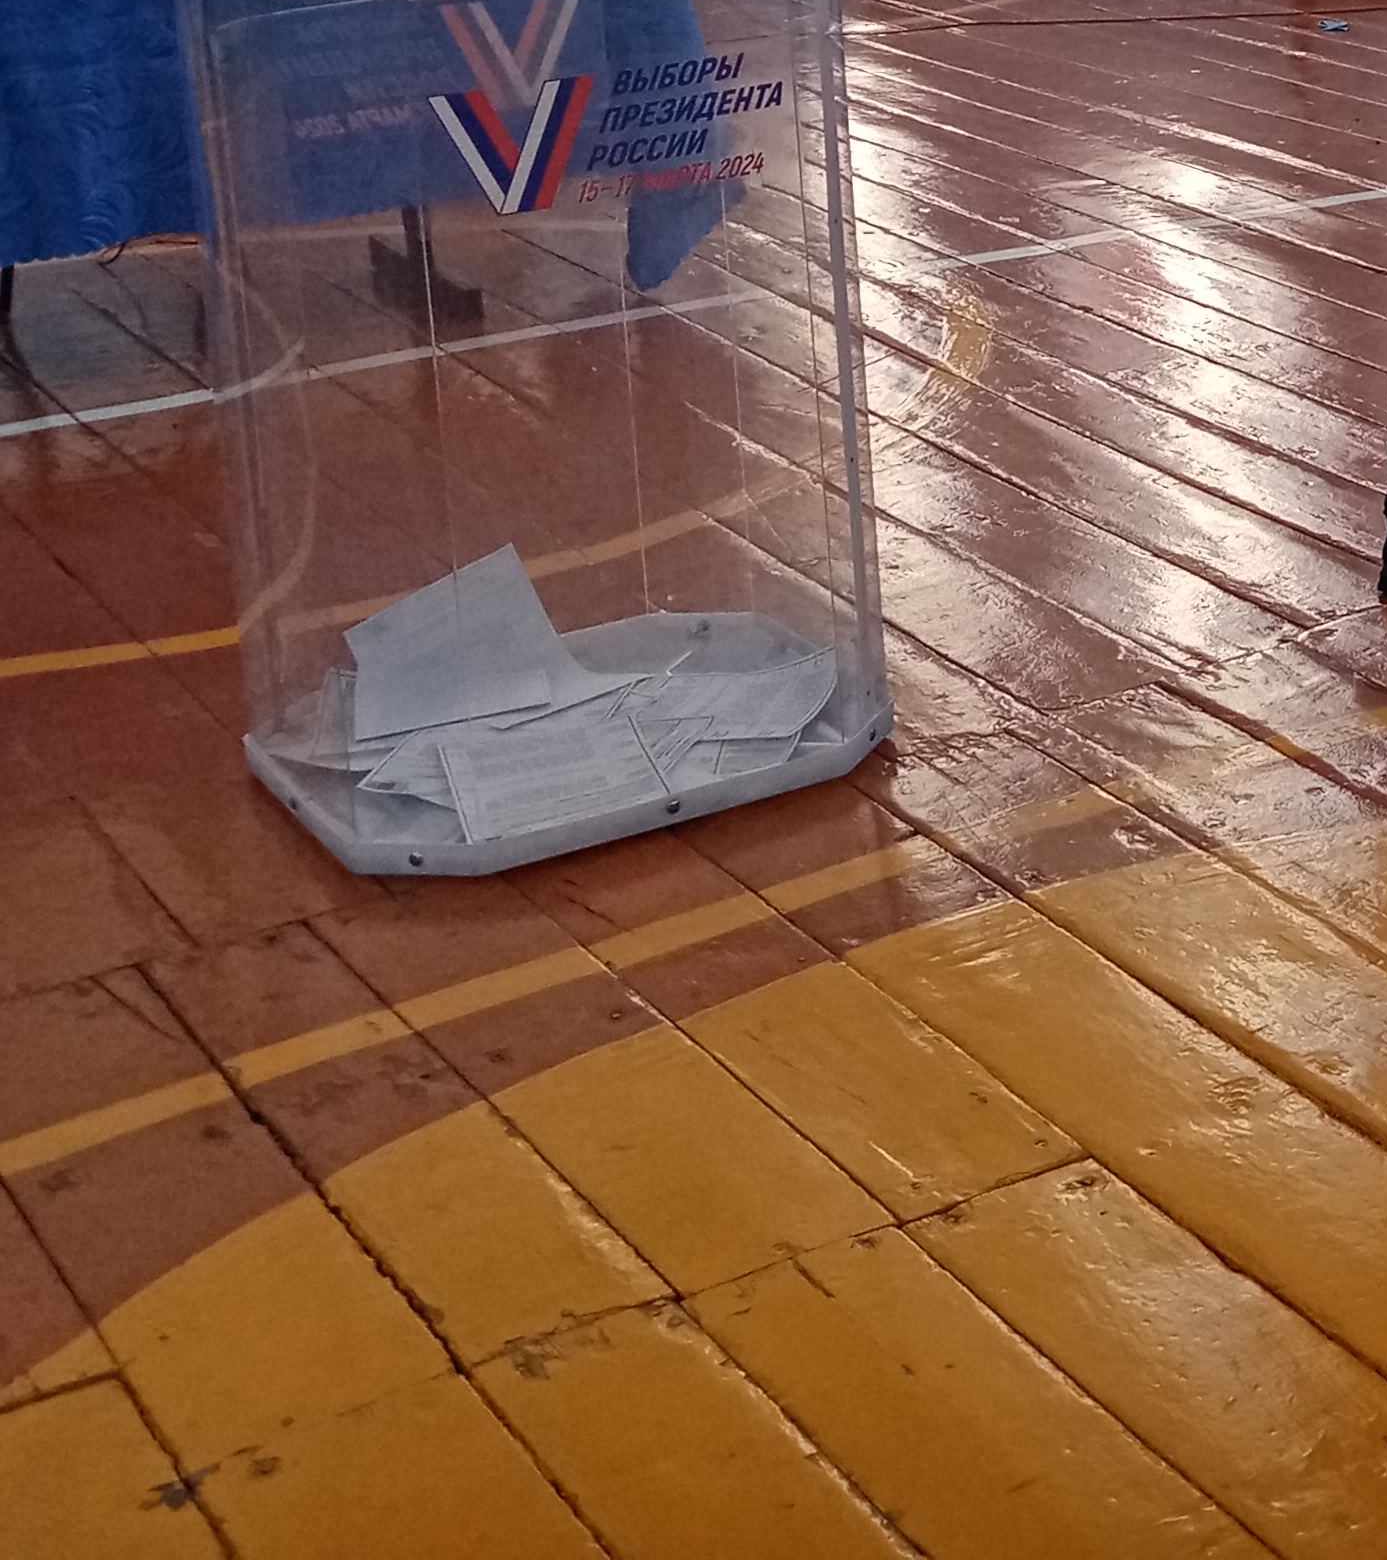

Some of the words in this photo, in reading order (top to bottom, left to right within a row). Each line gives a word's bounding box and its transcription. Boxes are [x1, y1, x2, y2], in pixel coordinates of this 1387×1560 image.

[611, 52, 744, 96] ВЫБОРЫ
[599, 81, 783, 134] ПРЕЗИДЕНТА
[586, 128, 709, 171] РОССИИ
[716, 152, 764, 181] 2024
